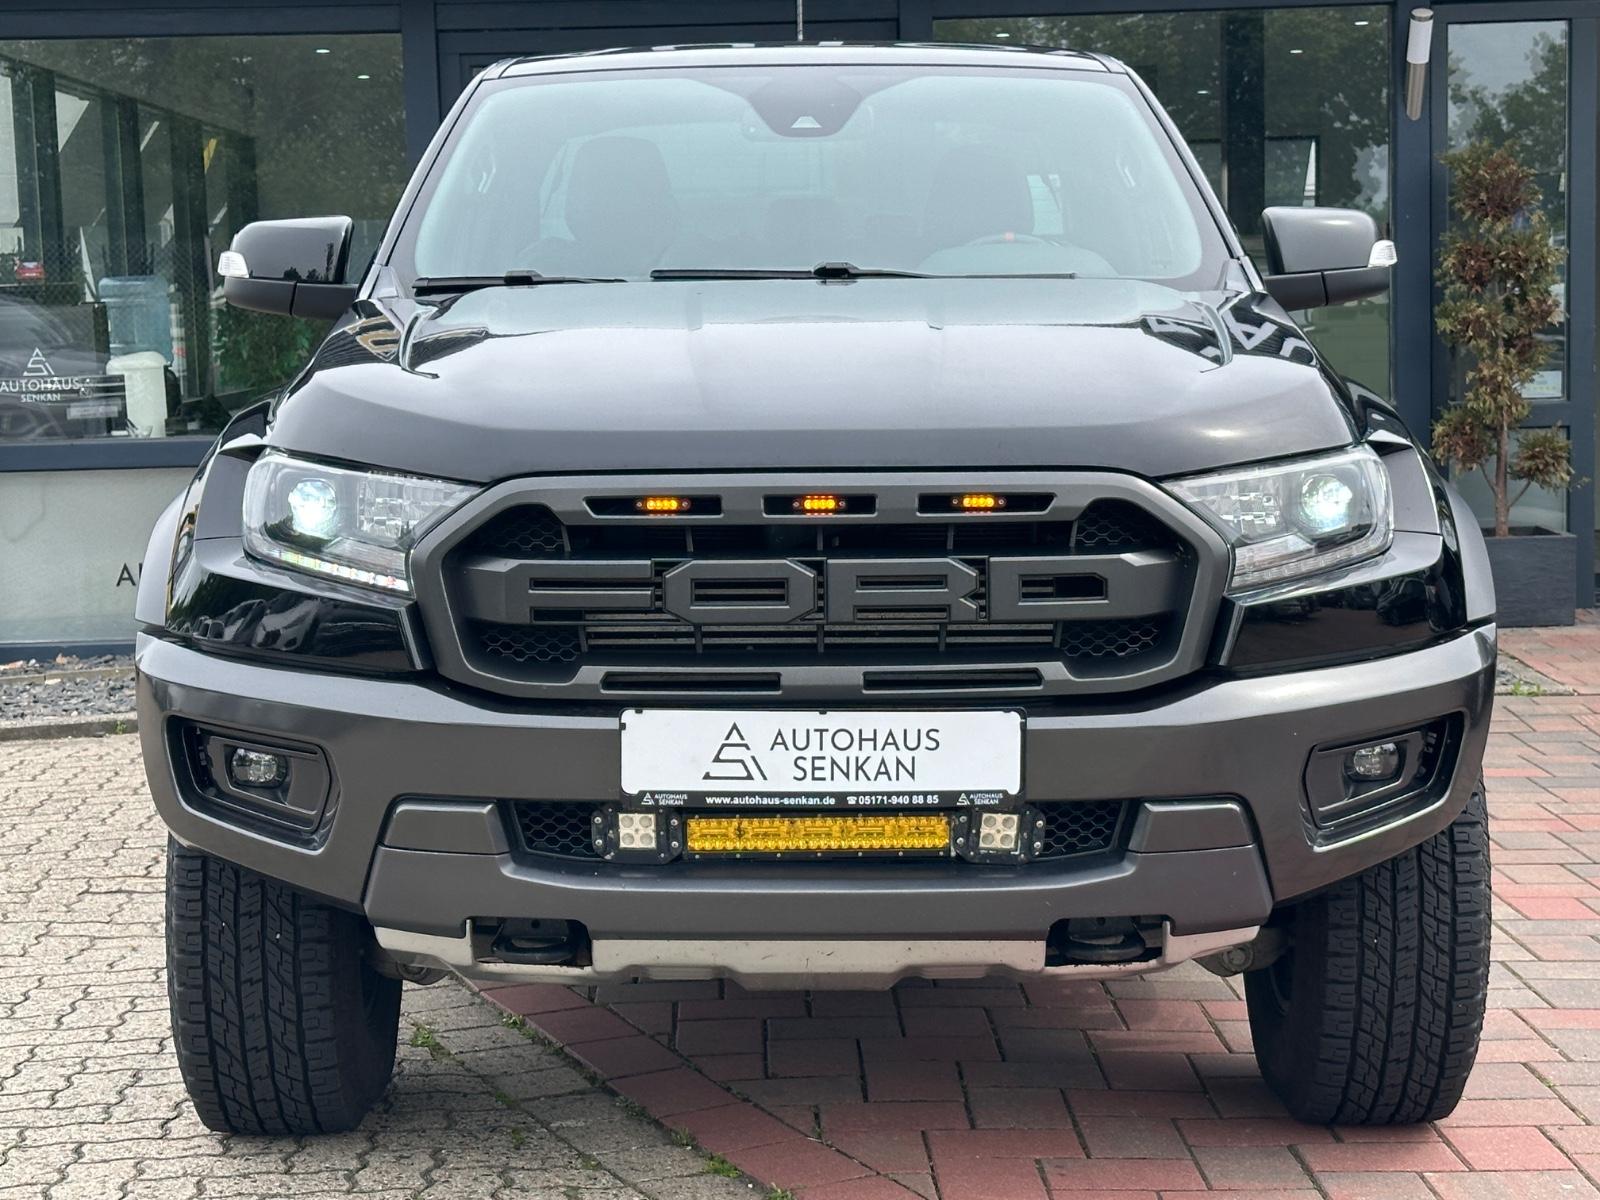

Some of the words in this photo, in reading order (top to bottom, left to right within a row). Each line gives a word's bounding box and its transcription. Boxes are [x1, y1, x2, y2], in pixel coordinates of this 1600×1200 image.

[0, 378, 81, 393] AUTOHAUS
[20, 393, 61, 402] SENKAN
[116, 563, 143, 587] A
[472, 556, 1176, 625] FORD
[770, 728, 940, 751] AUTOHAUS
[793, 755, 916, 781] SENKAN
[705, 795, 836, 806] www.autohaus-senkan.de
[858, 795, 909, 805] 05171-940
[912, 795, 923, 805] 88
[926, 795, 939, 804] 85
